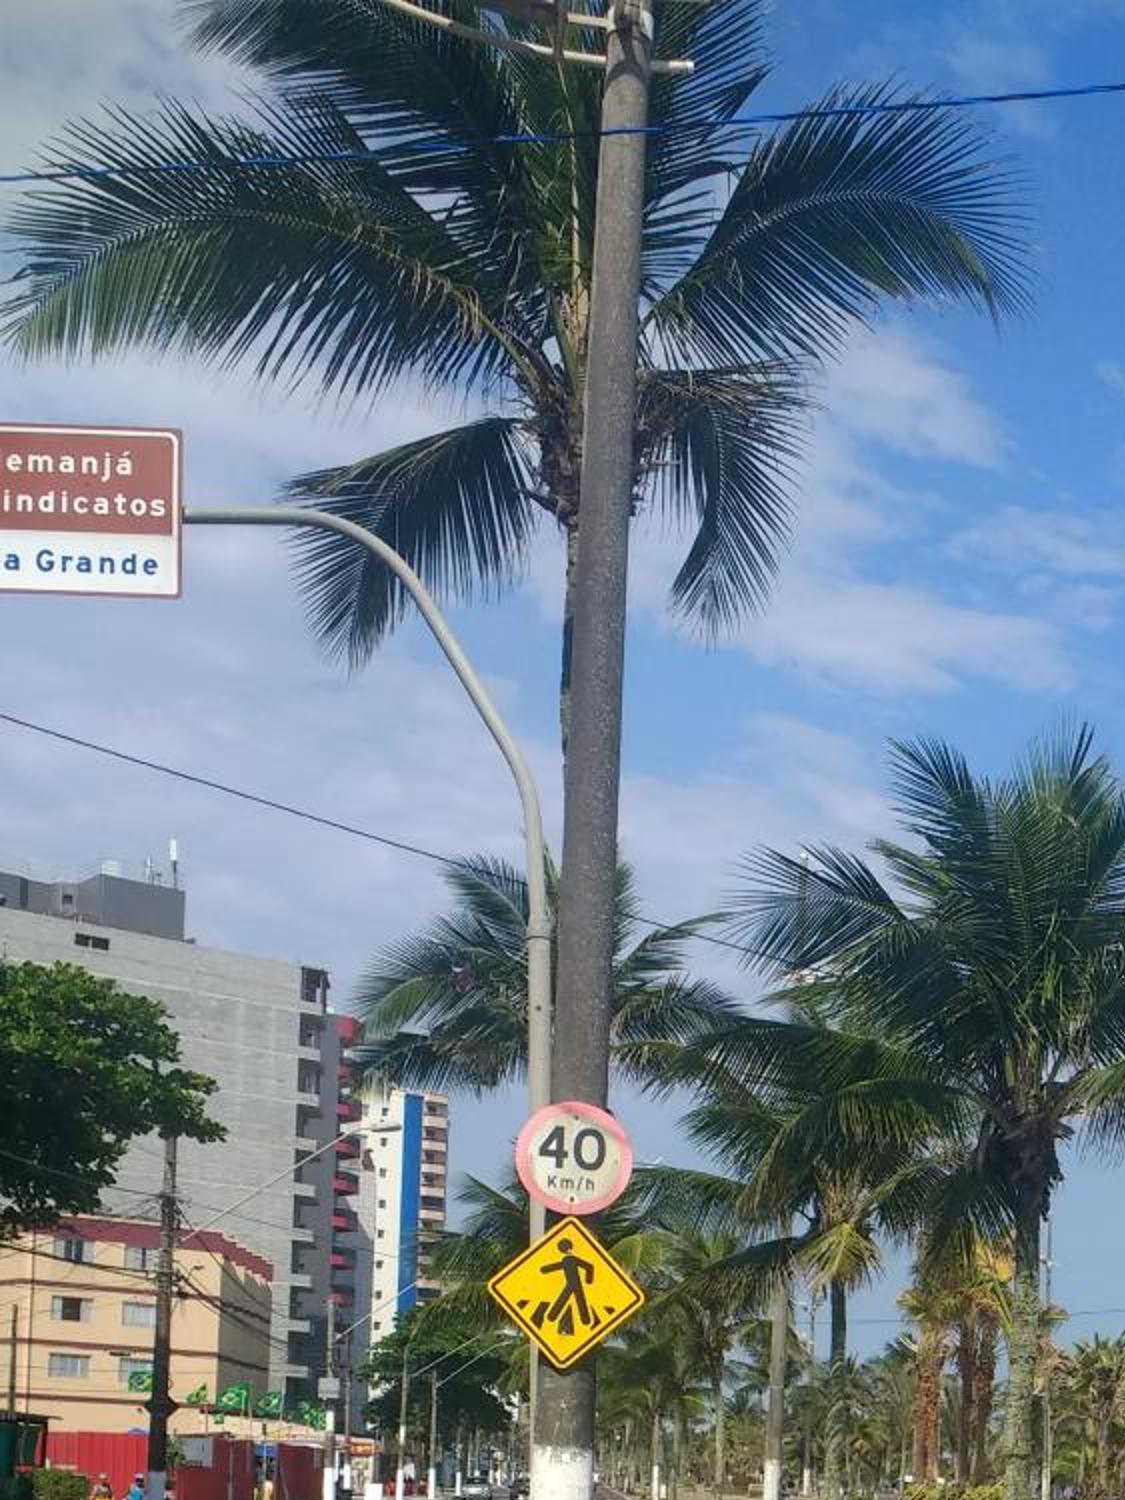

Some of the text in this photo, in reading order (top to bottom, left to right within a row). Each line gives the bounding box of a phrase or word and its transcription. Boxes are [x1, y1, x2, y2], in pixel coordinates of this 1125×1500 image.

[36, 549, 159, 575] Grande
[539, 1125, 606, 1171] 40
[547, 1174, 595, 1192] Km/h
